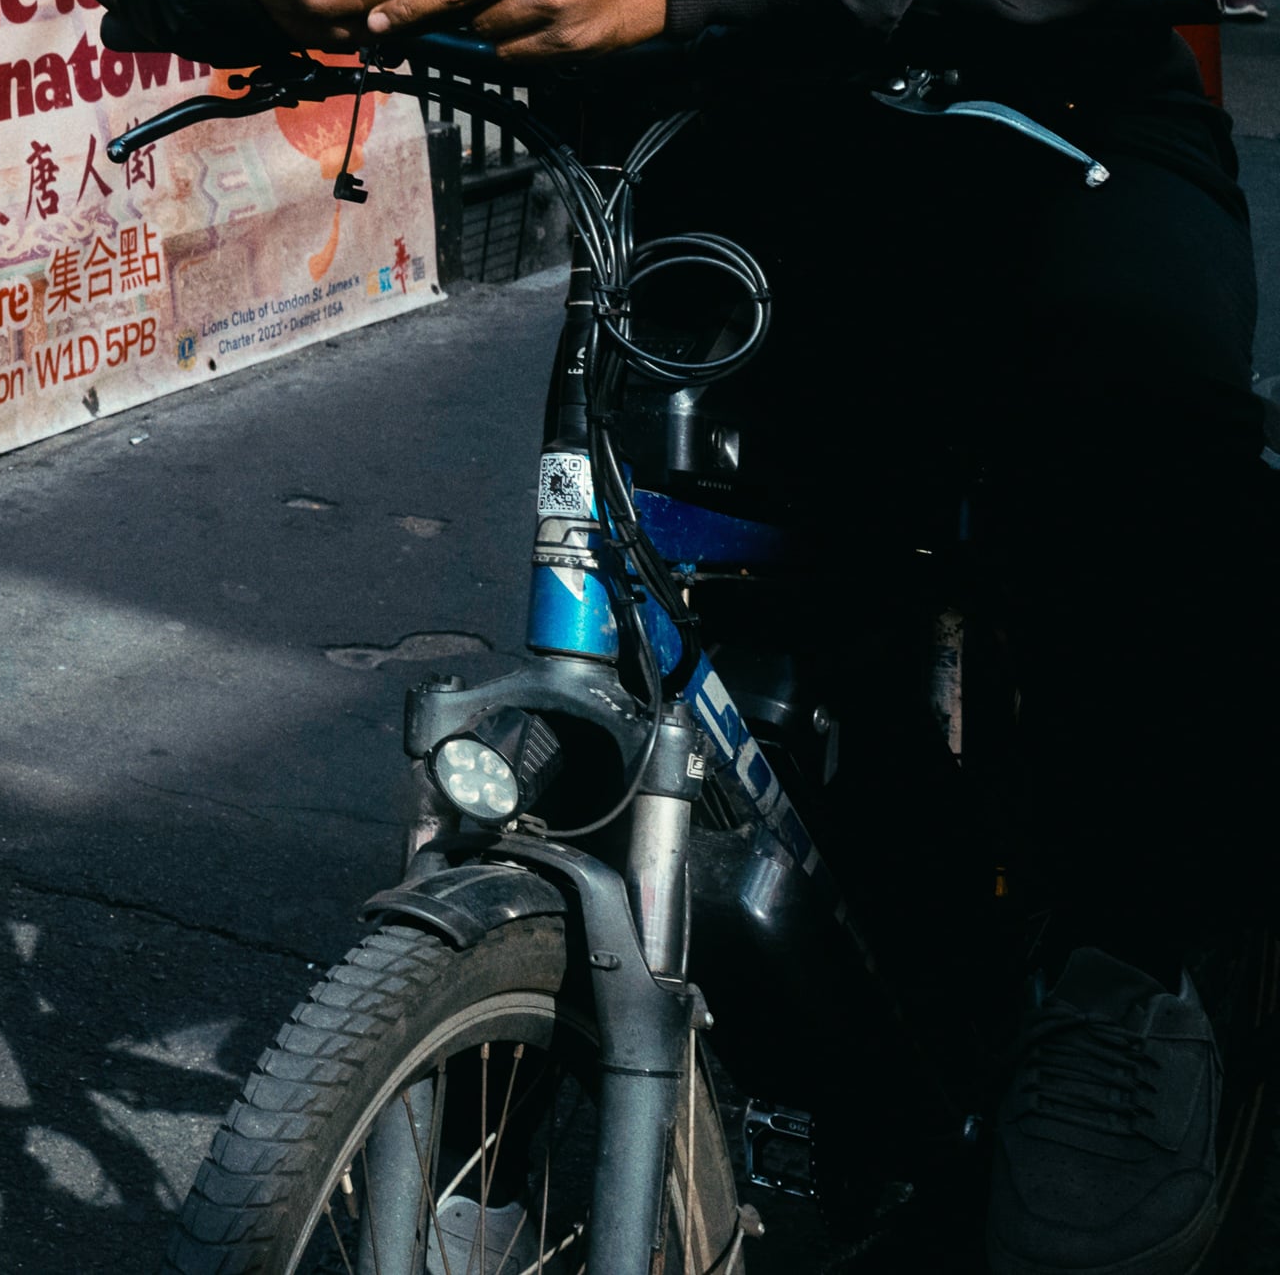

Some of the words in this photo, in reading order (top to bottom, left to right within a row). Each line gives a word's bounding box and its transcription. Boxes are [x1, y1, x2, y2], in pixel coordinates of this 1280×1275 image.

[47, 222, 161, 314] 集合點
[202, 318, 229, 337] Lions
[231, 308, 256, 327] Club
[258, 303, 269, 319] of
[271, 295, 310, 316] London
[312, 288, 323, 303] St
[325, 276, 360, 298] James's
[218, 333, 255, 355] Charter
[258, 323, 283, 342] 2023
[290, 311, 321, 331] District
[323, 302, 344, 319] 105A
[34, 334, 99, 389] W1D
[106, 317, 157, 367] 5PB
